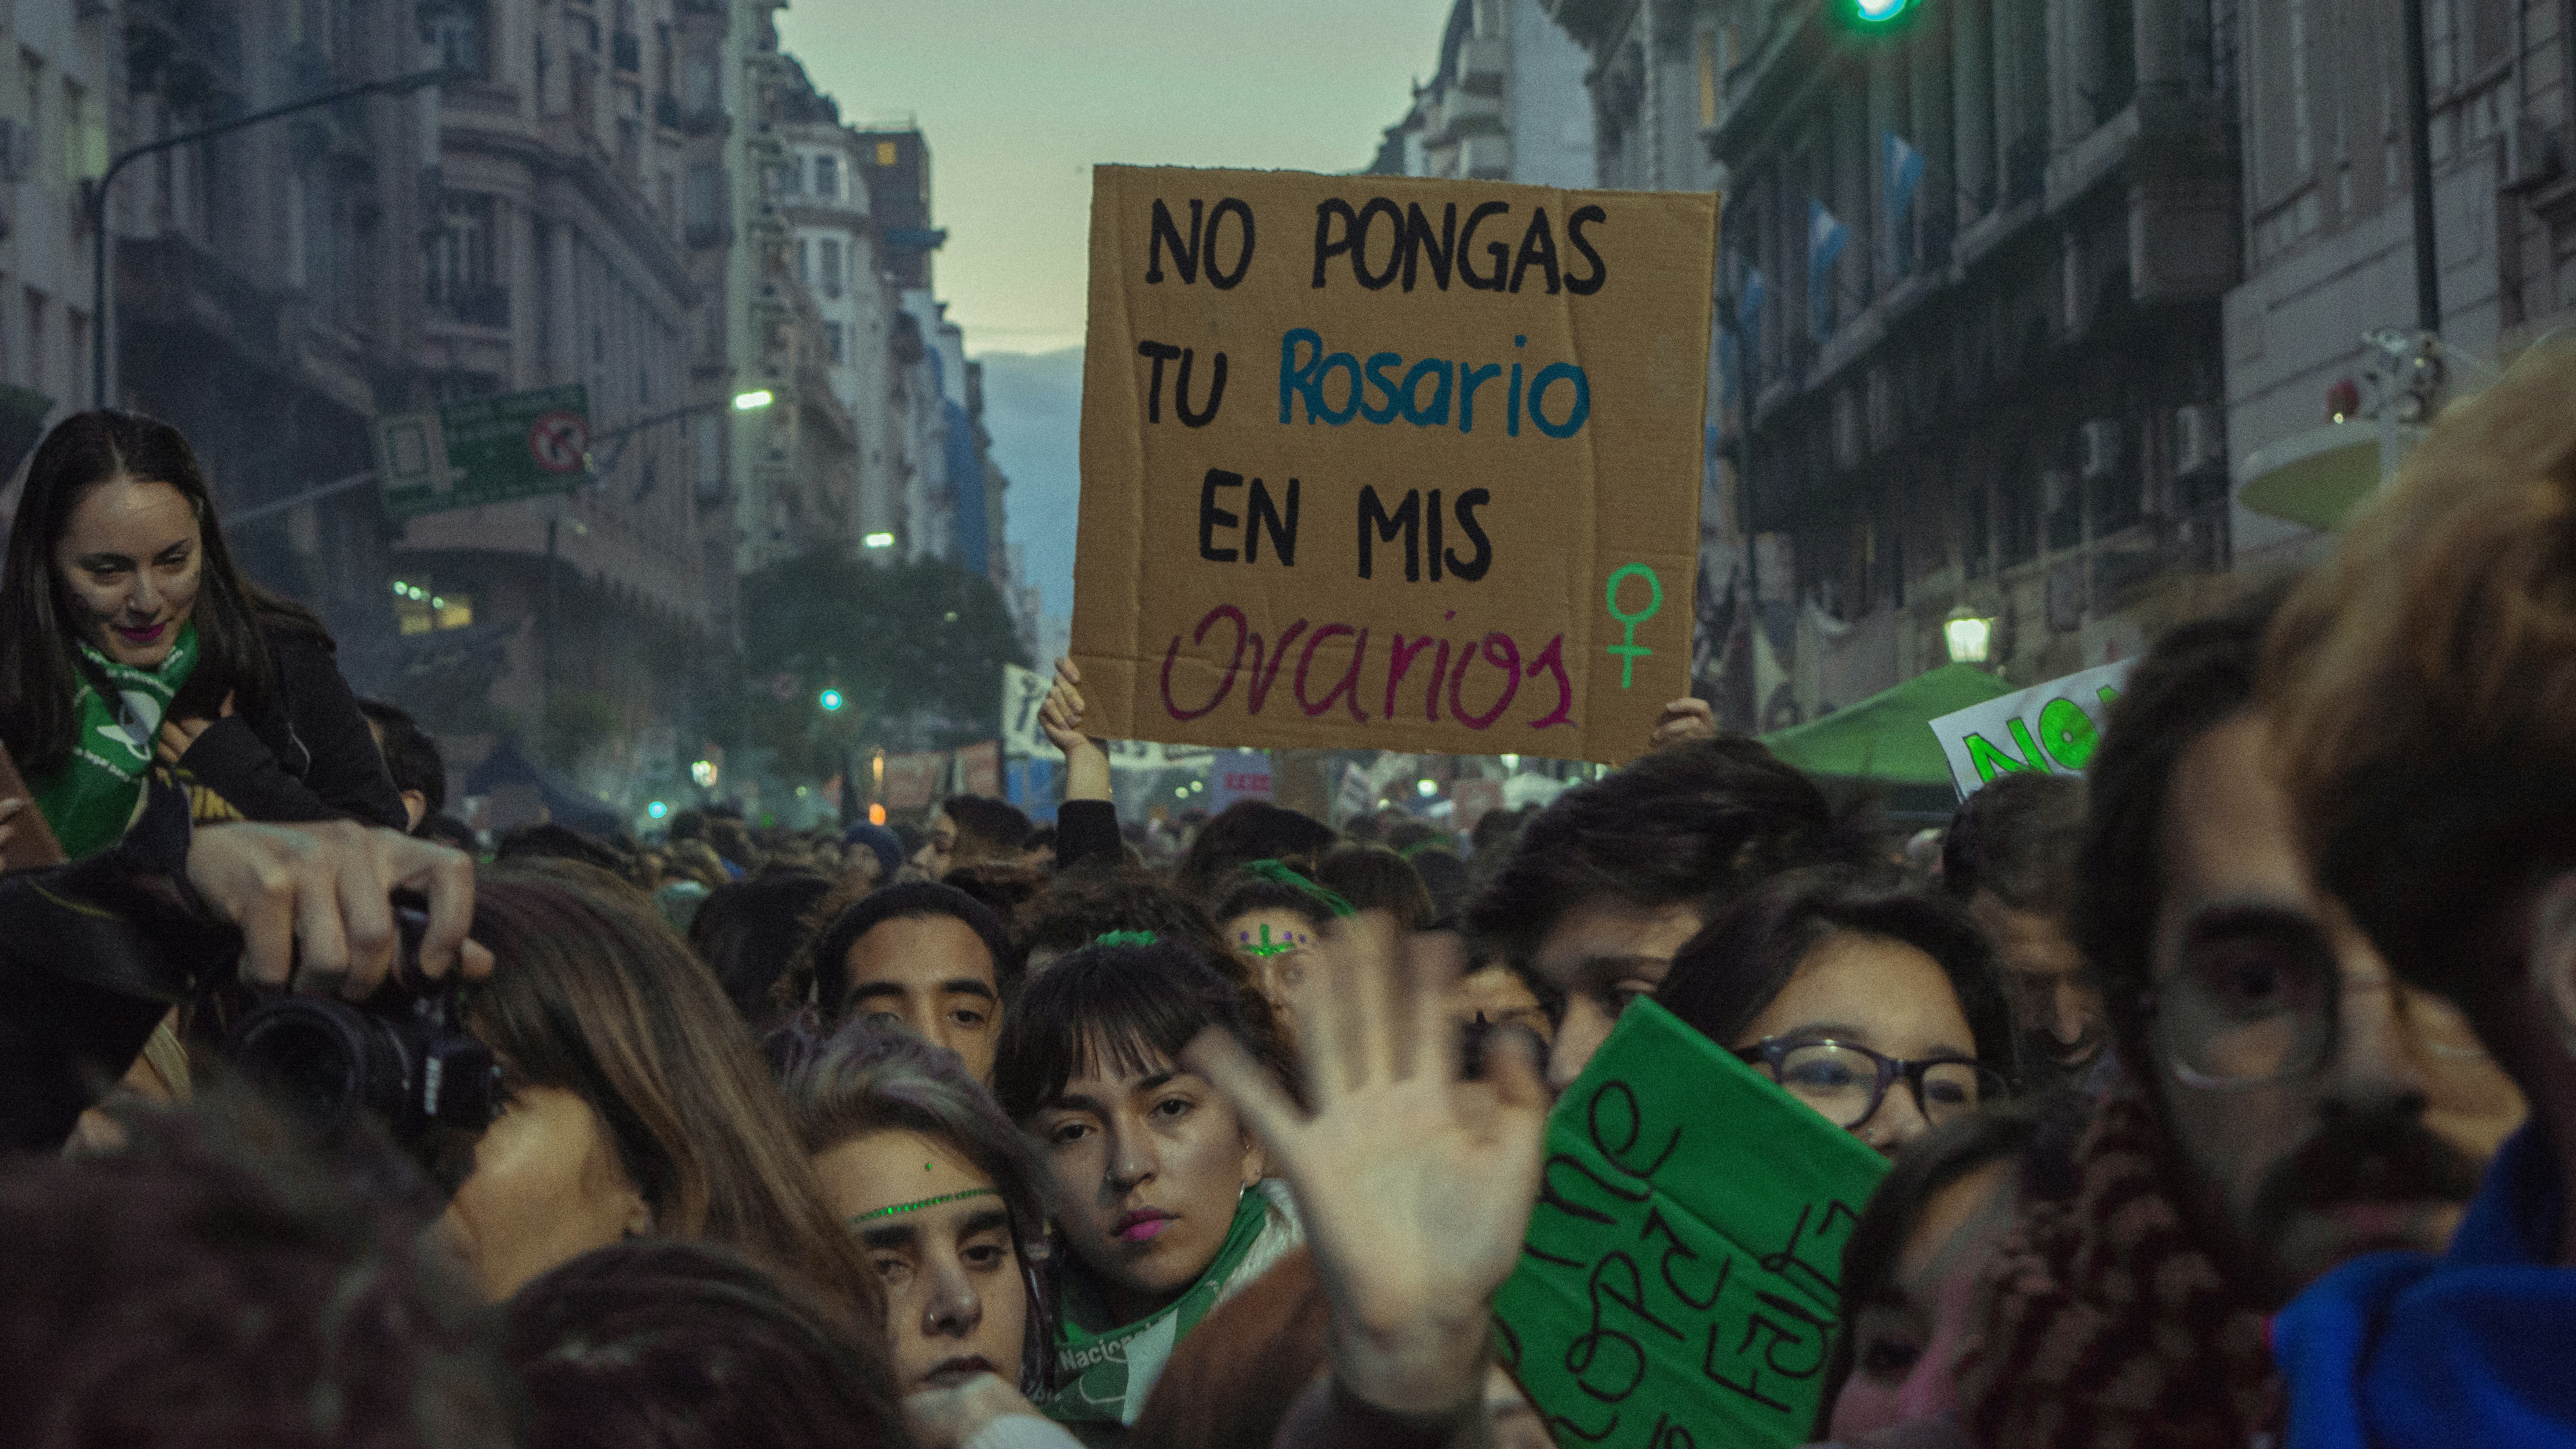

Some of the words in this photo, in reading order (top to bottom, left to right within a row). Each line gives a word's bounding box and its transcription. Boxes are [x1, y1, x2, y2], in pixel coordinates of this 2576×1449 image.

[1145, 197, 1255, 290] NO
[1312, 197, 1607, 295] PONGAS
[1138, 340, 1227, 428] TU
[1279, 328, 1590, 438] Rosario
[1200, 468, 1300, 567] EN
[1358, 484, 1492, 582] MIS
[1160, 605, 1577, 729] Ovarios
[1963, 685, 2119, 783] NO
[1058, 1322, 1151, 1370] Nacio
